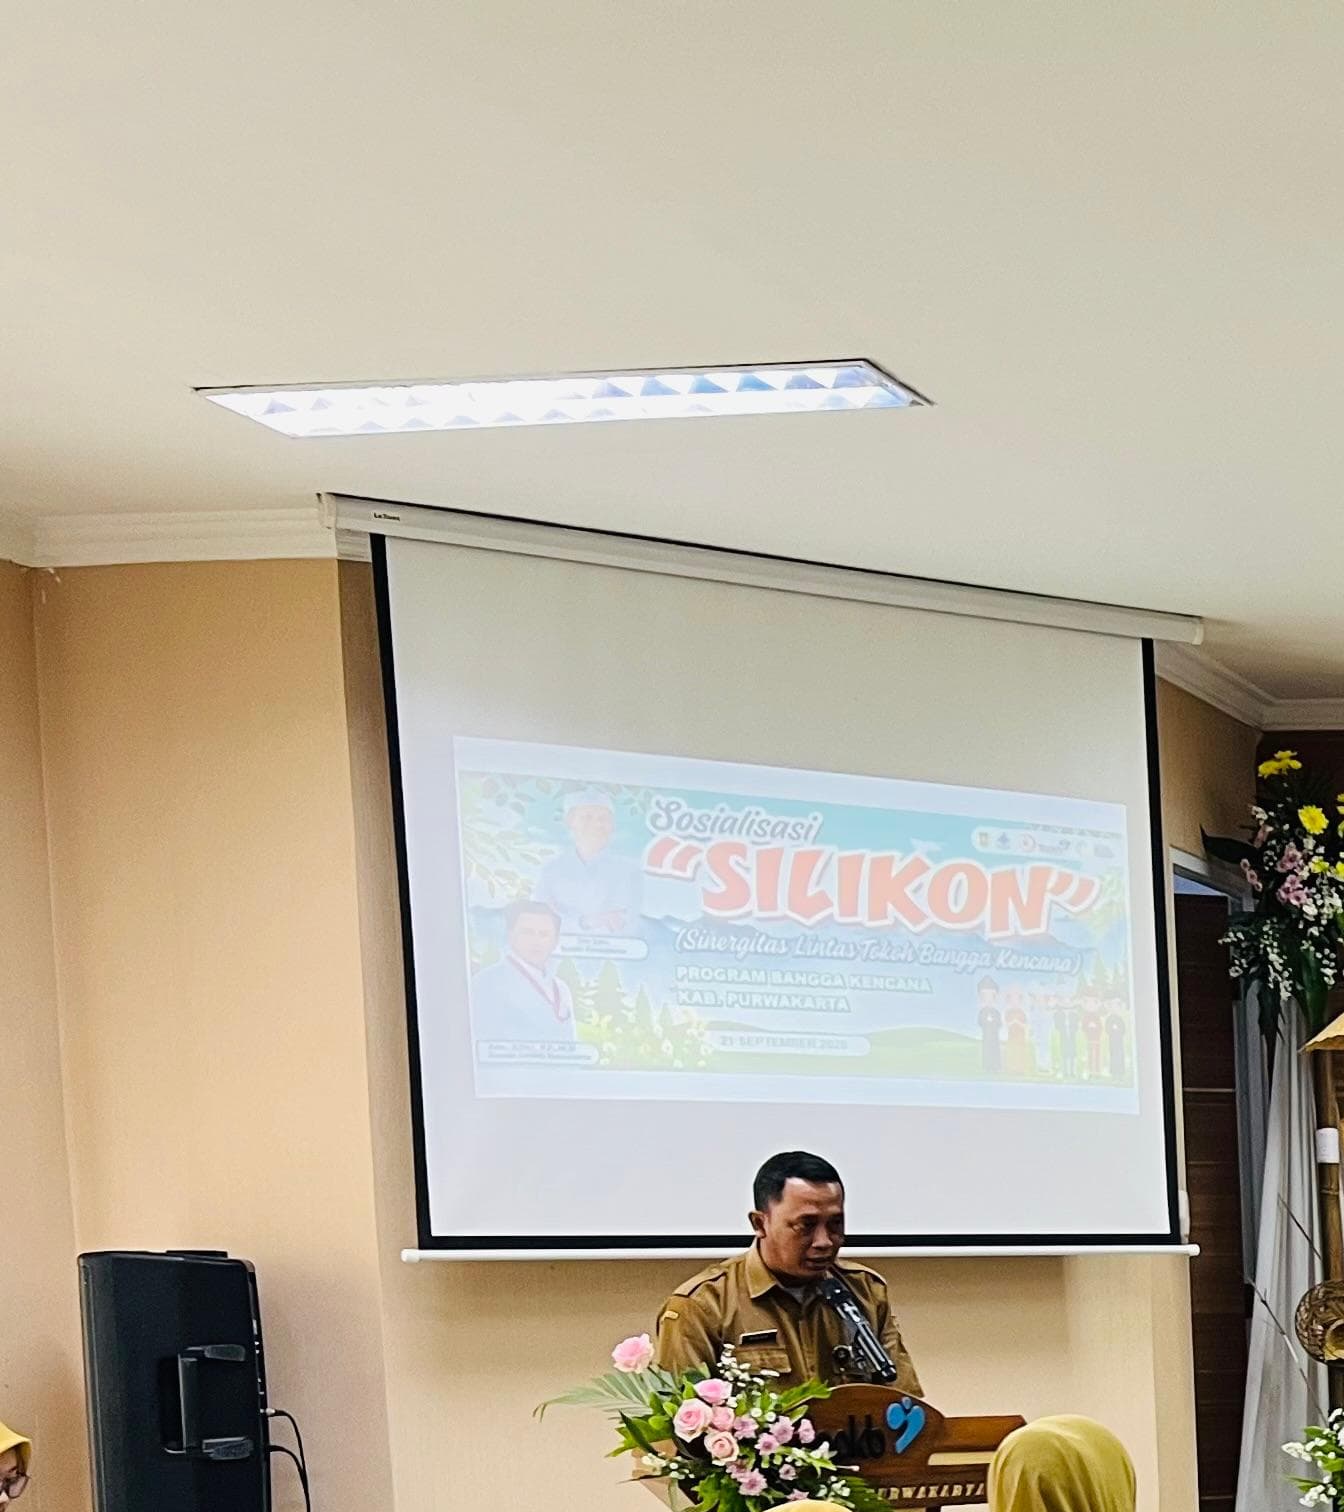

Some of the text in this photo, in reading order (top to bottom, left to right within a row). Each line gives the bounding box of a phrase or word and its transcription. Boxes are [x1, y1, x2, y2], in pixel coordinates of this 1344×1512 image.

[649, 798, 821, 843] Sosialisasi
[676, 966, 933, 993] PROGRAM BANGGA KENCANA
[726, 992, 851, 1012] PURWAKARTA
[877, 1480, 986, 1502] URWAKARTA
